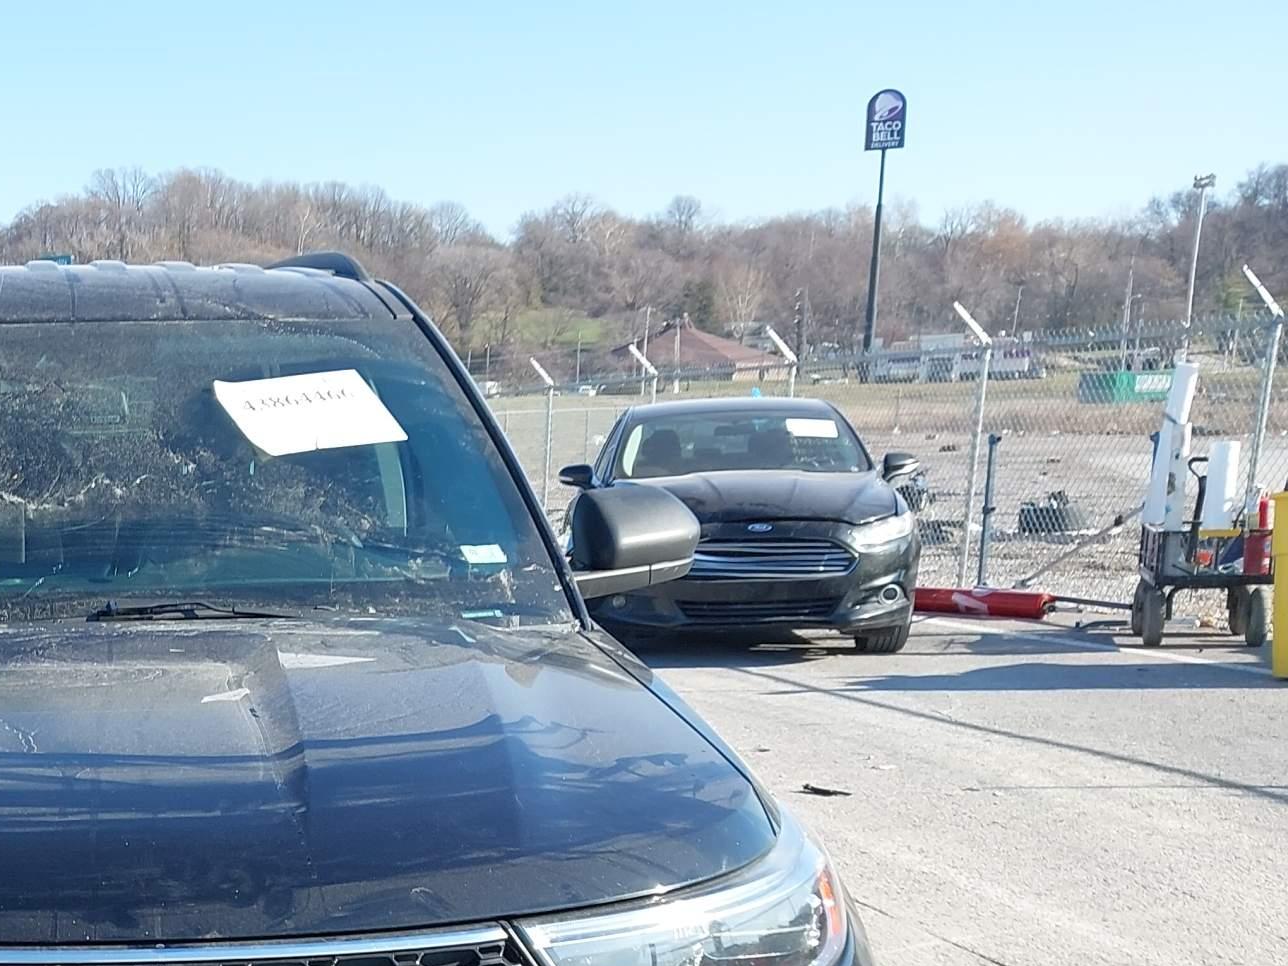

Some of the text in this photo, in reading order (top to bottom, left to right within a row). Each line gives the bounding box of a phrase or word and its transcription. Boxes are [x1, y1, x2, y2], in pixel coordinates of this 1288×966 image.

[870, 120, 902, 133] TACO
[872, 131, 901, 142] BELL
[871, 141, 900, 149] DELIVERY
